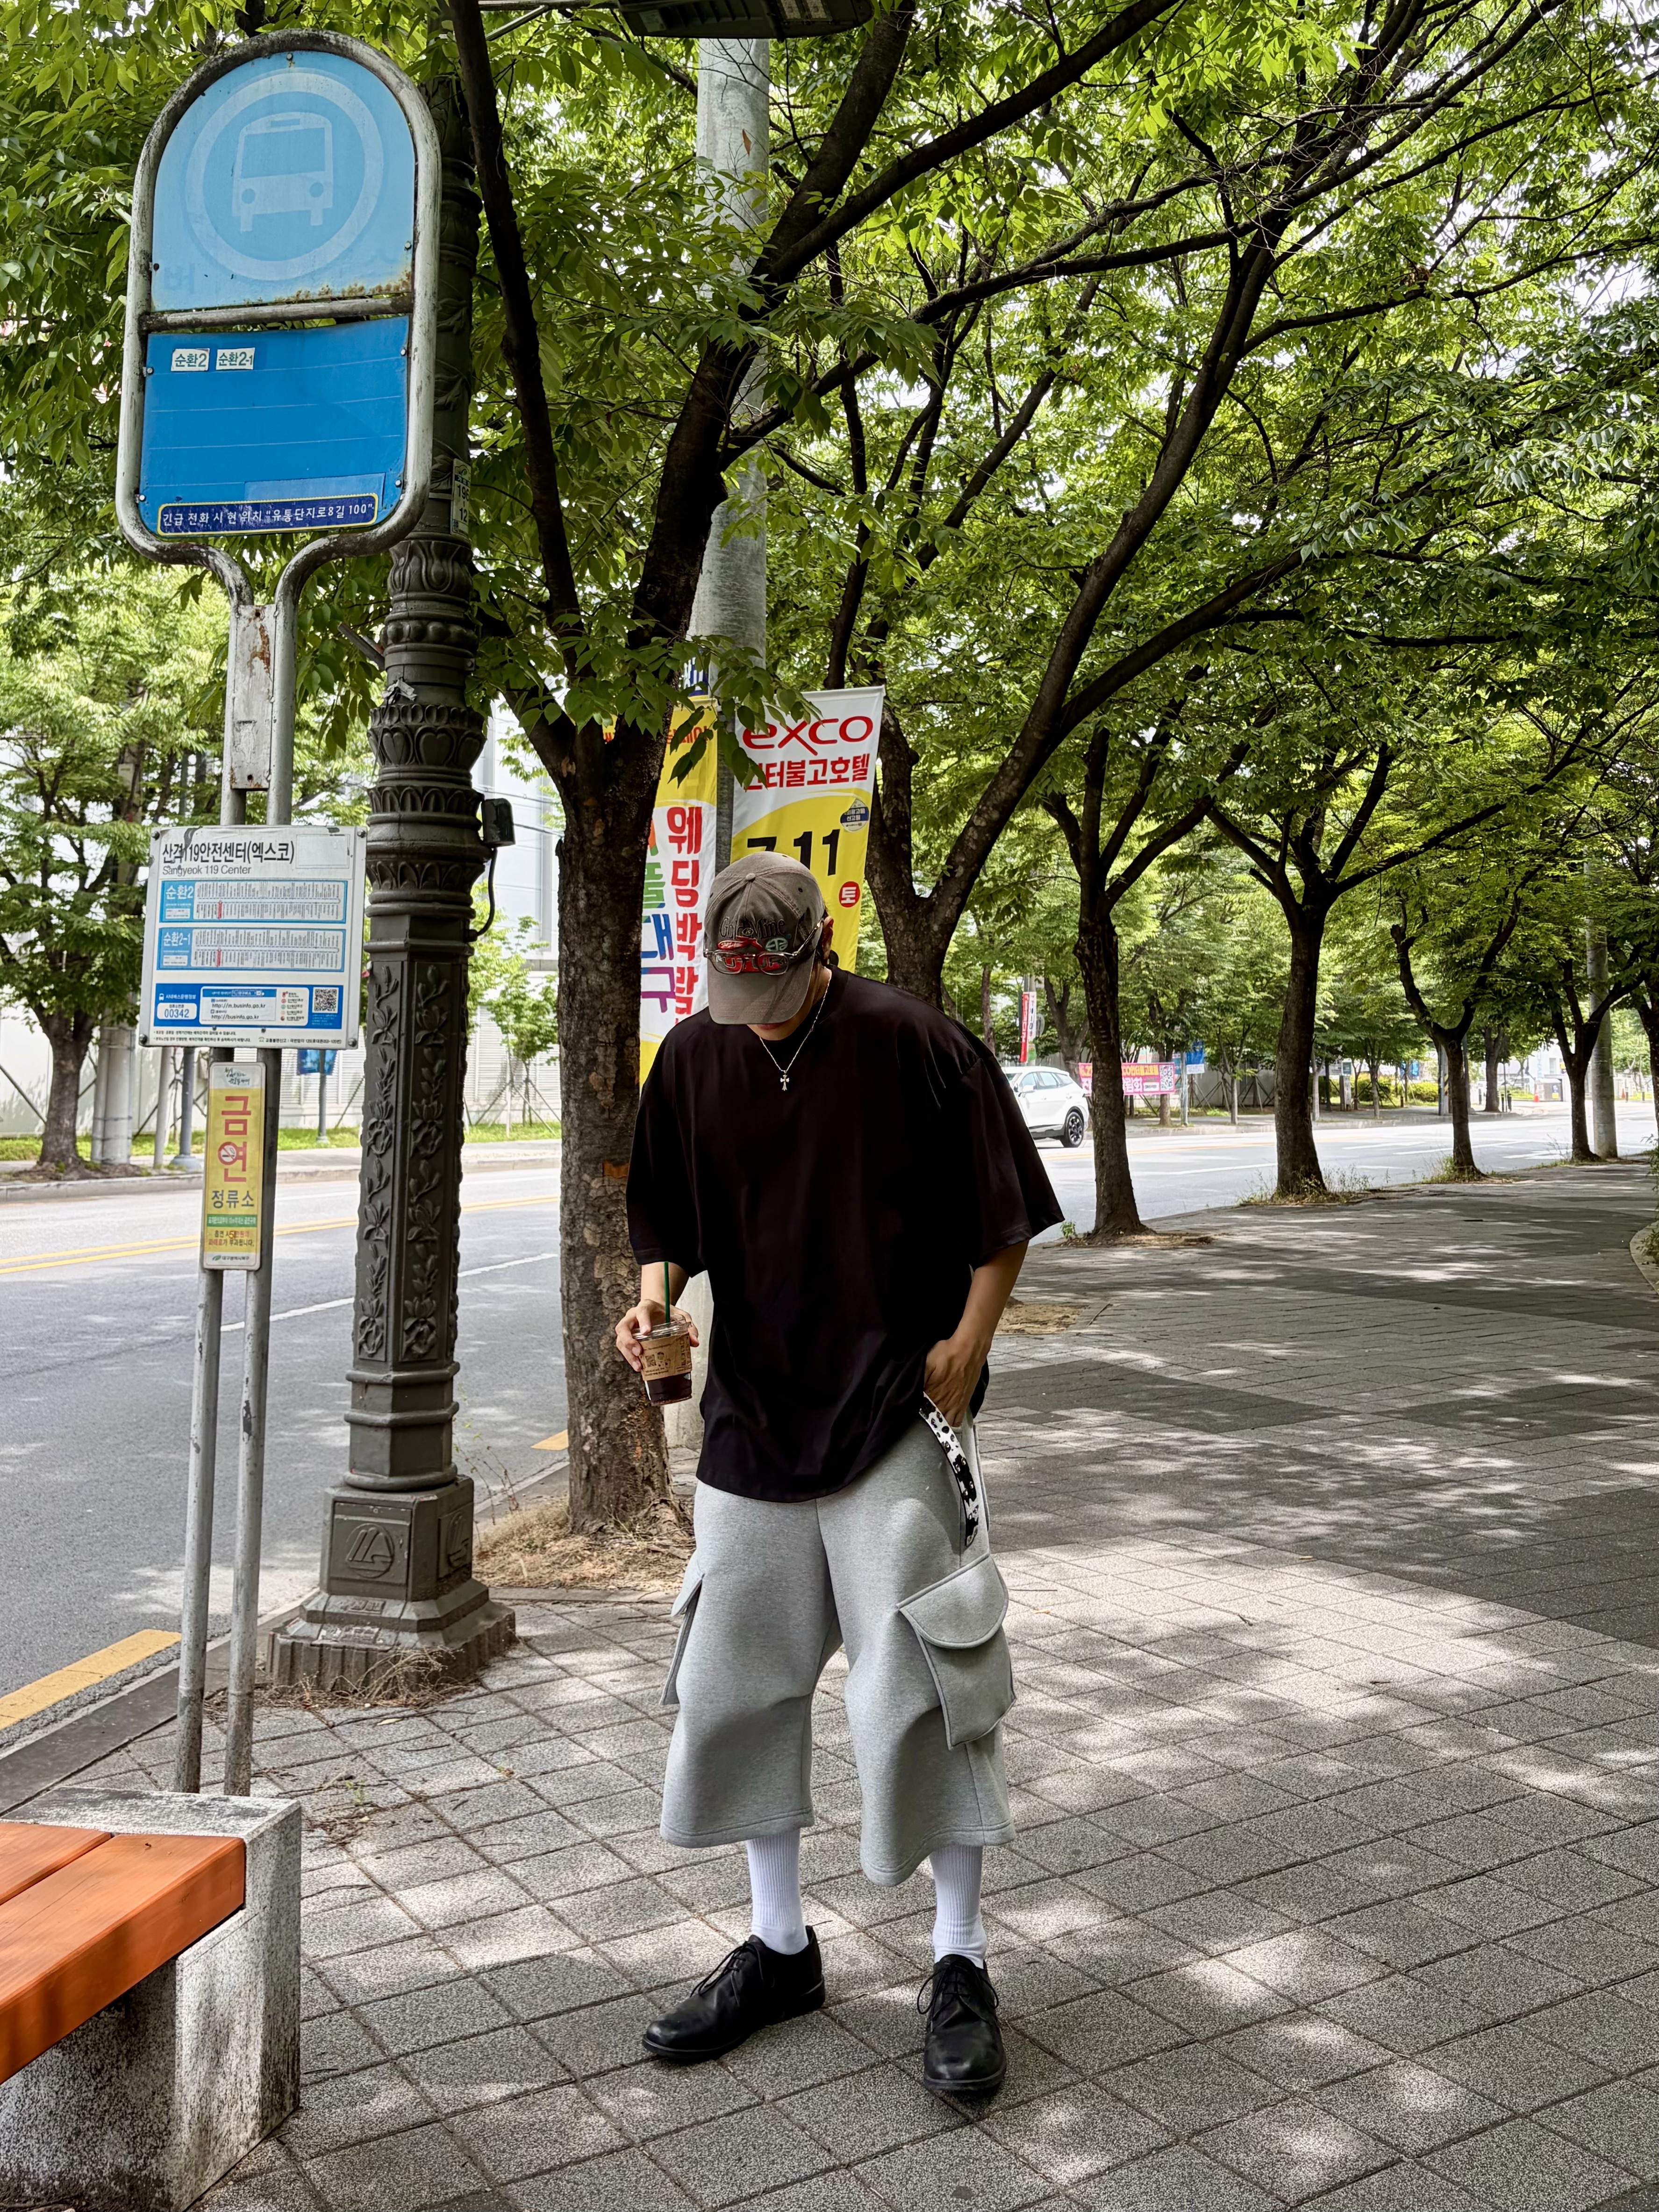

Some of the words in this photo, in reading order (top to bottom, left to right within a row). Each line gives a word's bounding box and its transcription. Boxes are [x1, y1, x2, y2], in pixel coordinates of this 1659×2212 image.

[175, 353, 207, 367] 순환2
[218, 351, 252, 366] 순환2-1
[164, 513, 184, 526] 긴급
[188, 512, 209, 526] 전화
[214, 512, 223, 523] 시
[163, 866, 202, 877] Sangyeok
[206, 866, 218, 874] 119
[221, 866, 251, 874] Center
[165, 885, 193, 900] 순환2
[841, 886, 857, 904] 토
[667, 807, 702, 1024] 웨딩박람
[164, 931, 190, 946] 순환2-1
[164, 1009, 189, 1018] 00342
[218, 1096, 252, 1182] 금연
[212, 1190, 254, 1209] 정류소
